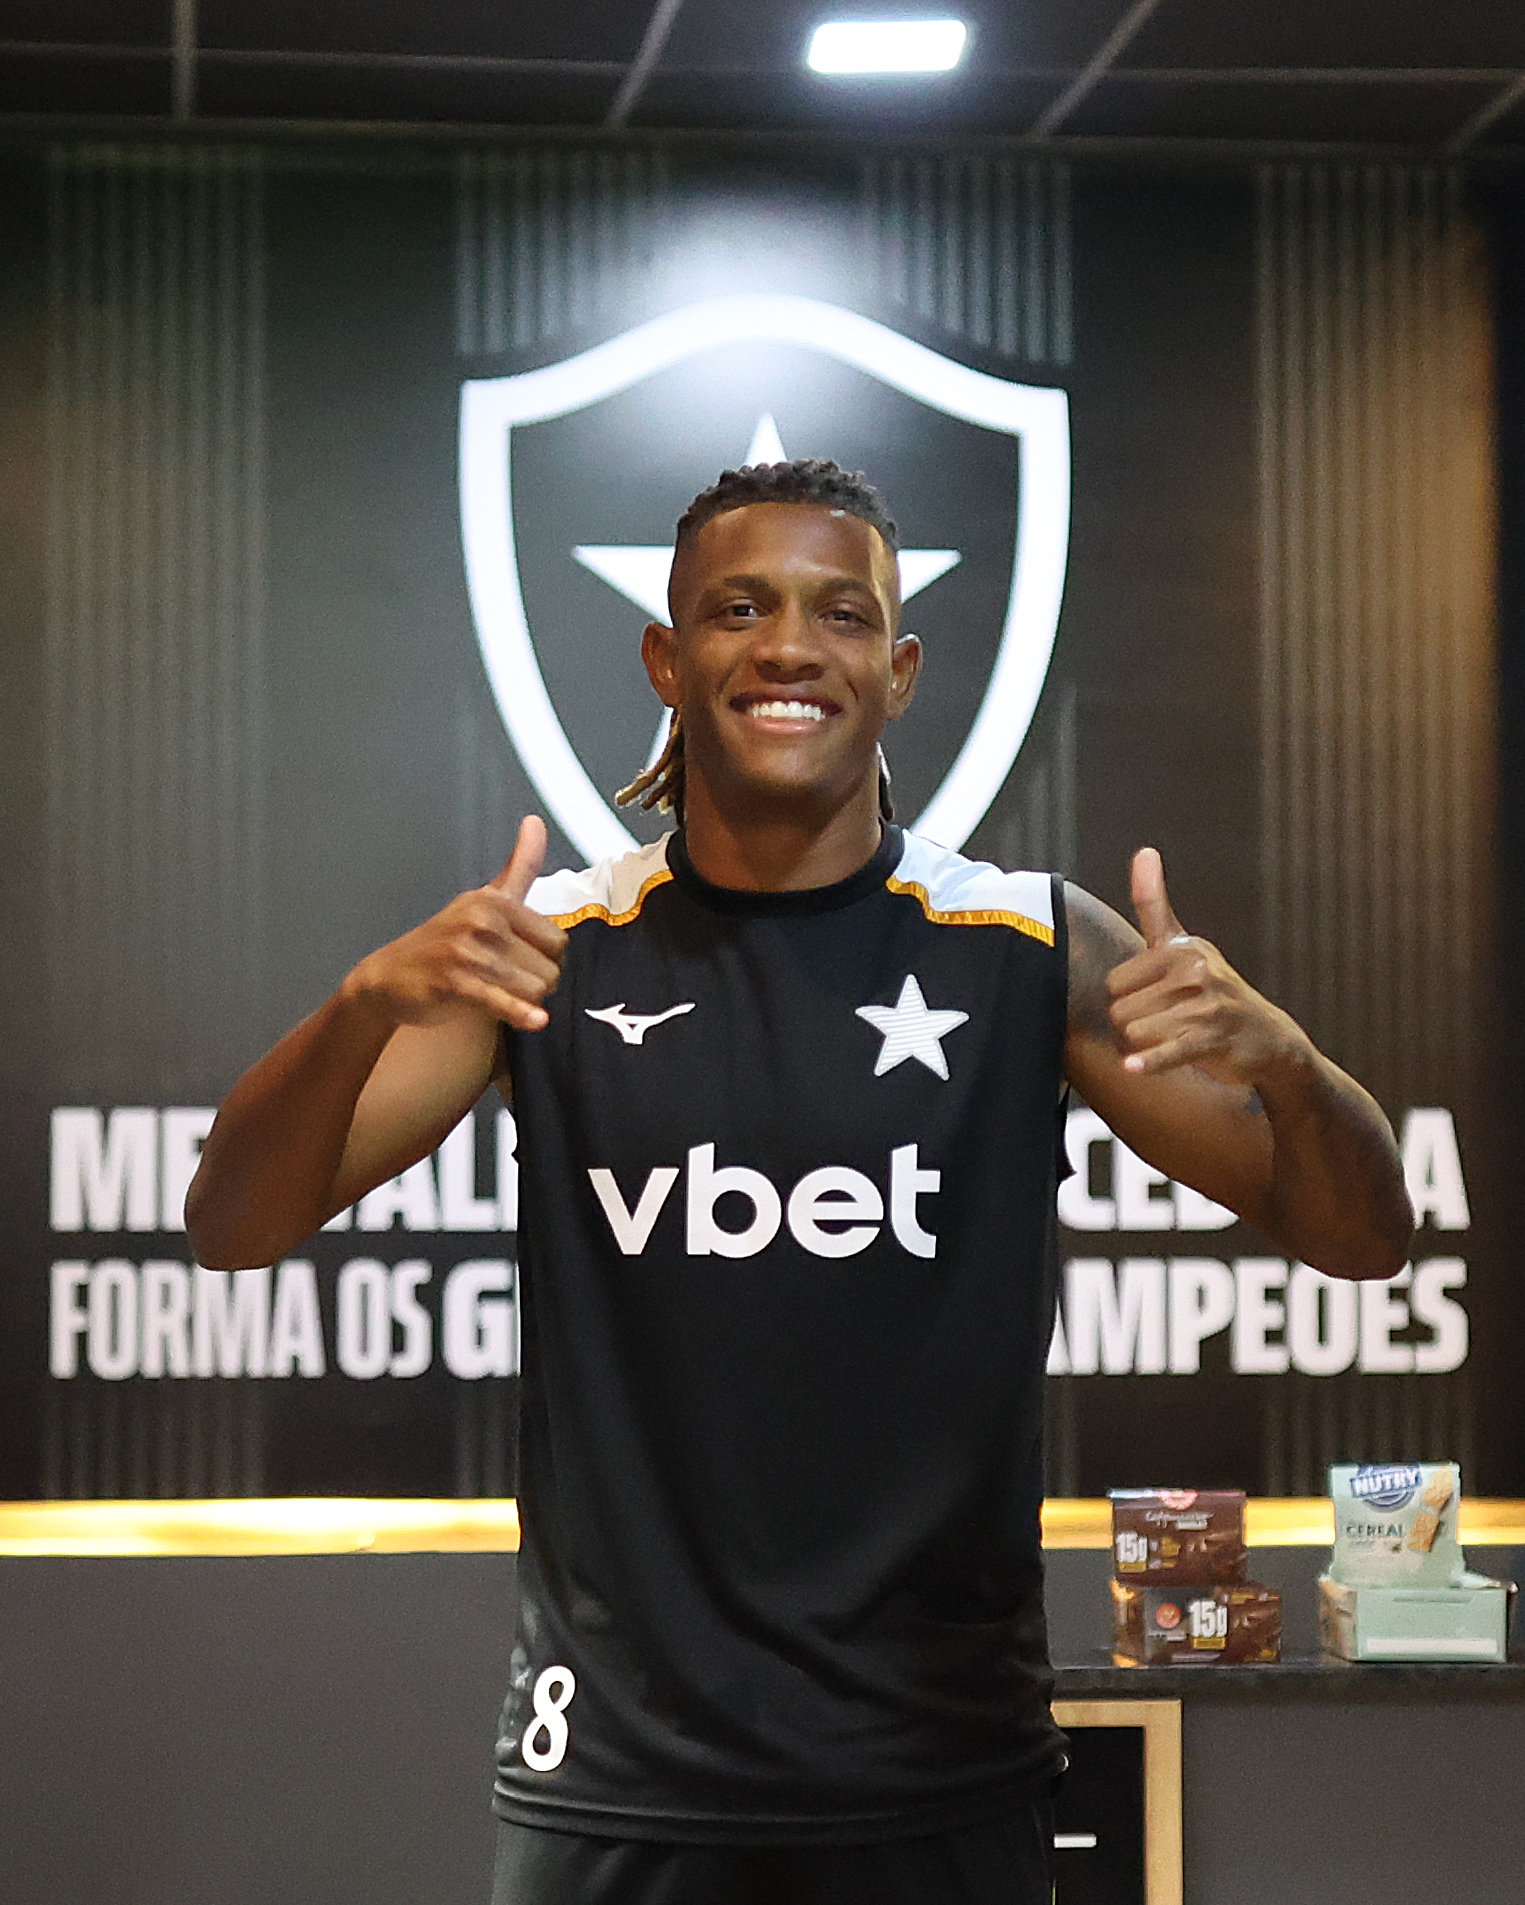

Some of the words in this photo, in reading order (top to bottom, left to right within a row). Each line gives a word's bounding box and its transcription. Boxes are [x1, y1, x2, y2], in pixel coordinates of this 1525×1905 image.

[587, 1142, 941, 1258] vbet
[50, 1257, 327, 1380] FORMA
[336, 1257, 433, 1379] OS
[522, 1665, 576, 1772] 8
